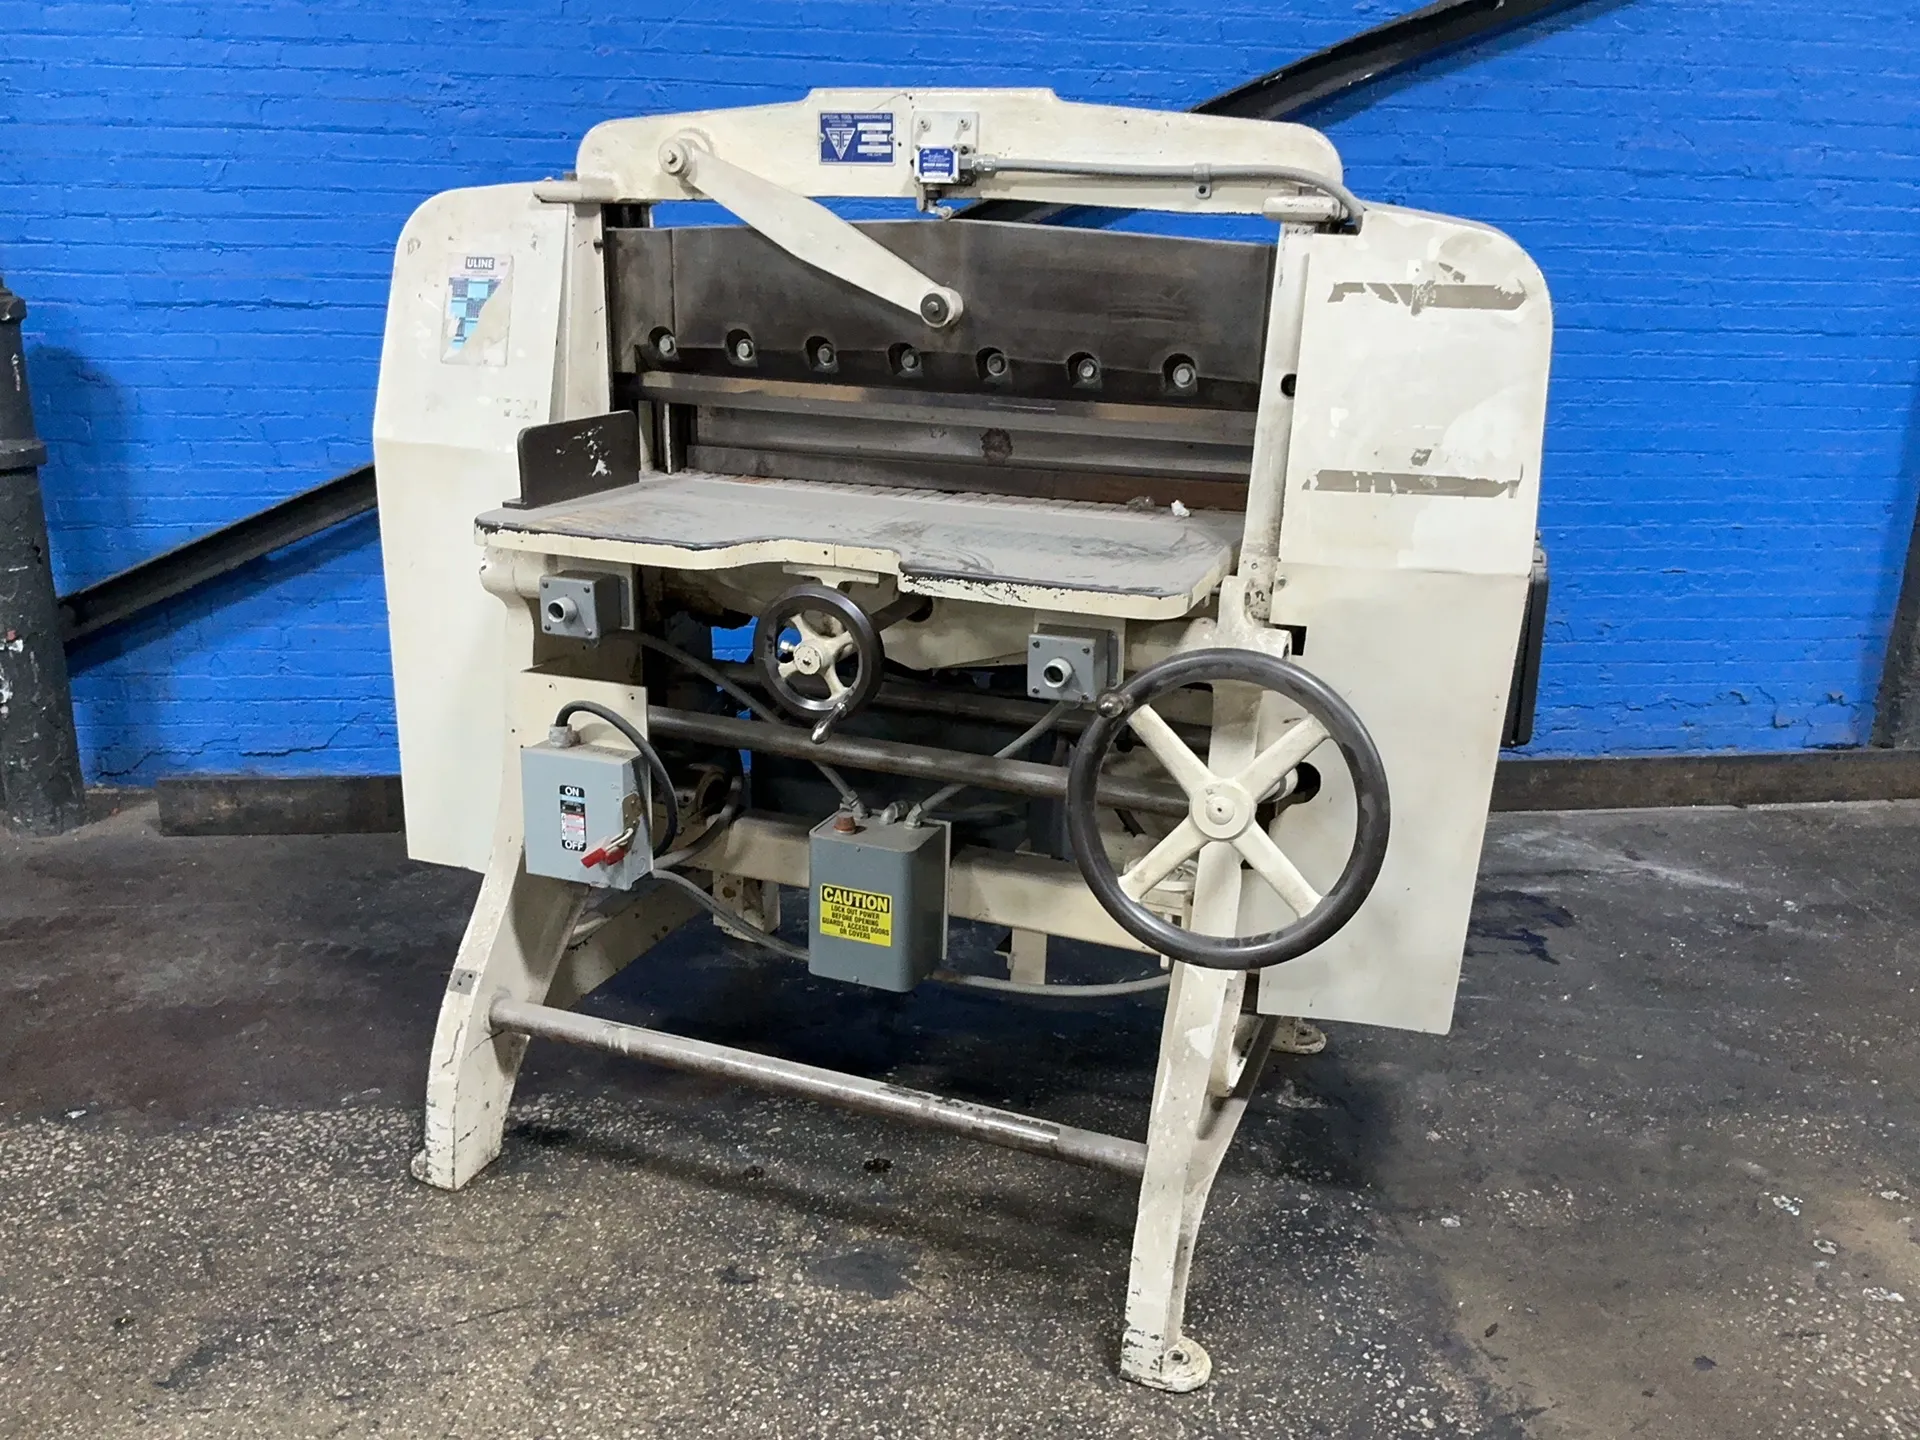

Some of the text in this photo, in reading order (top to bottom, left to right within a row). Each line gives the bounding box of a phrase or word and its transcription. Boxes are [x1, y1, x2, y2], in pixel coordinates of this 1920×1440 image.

[467, 258, 493, 268] ULINE
[565, 786, 579, 797] ON
[564, 840, 583, 850] OFF
[823, 887, 888, 912] CAUTION
[831, 905, 845, 913] LOCK
[859, 910, 880, 919] POWER
[831, 912, 879, 927] BEFORE OPENING
[822, 917, 889, 936] GUARDS, ACCESS DOORS
[848, 929, 871, 939] COVERS
